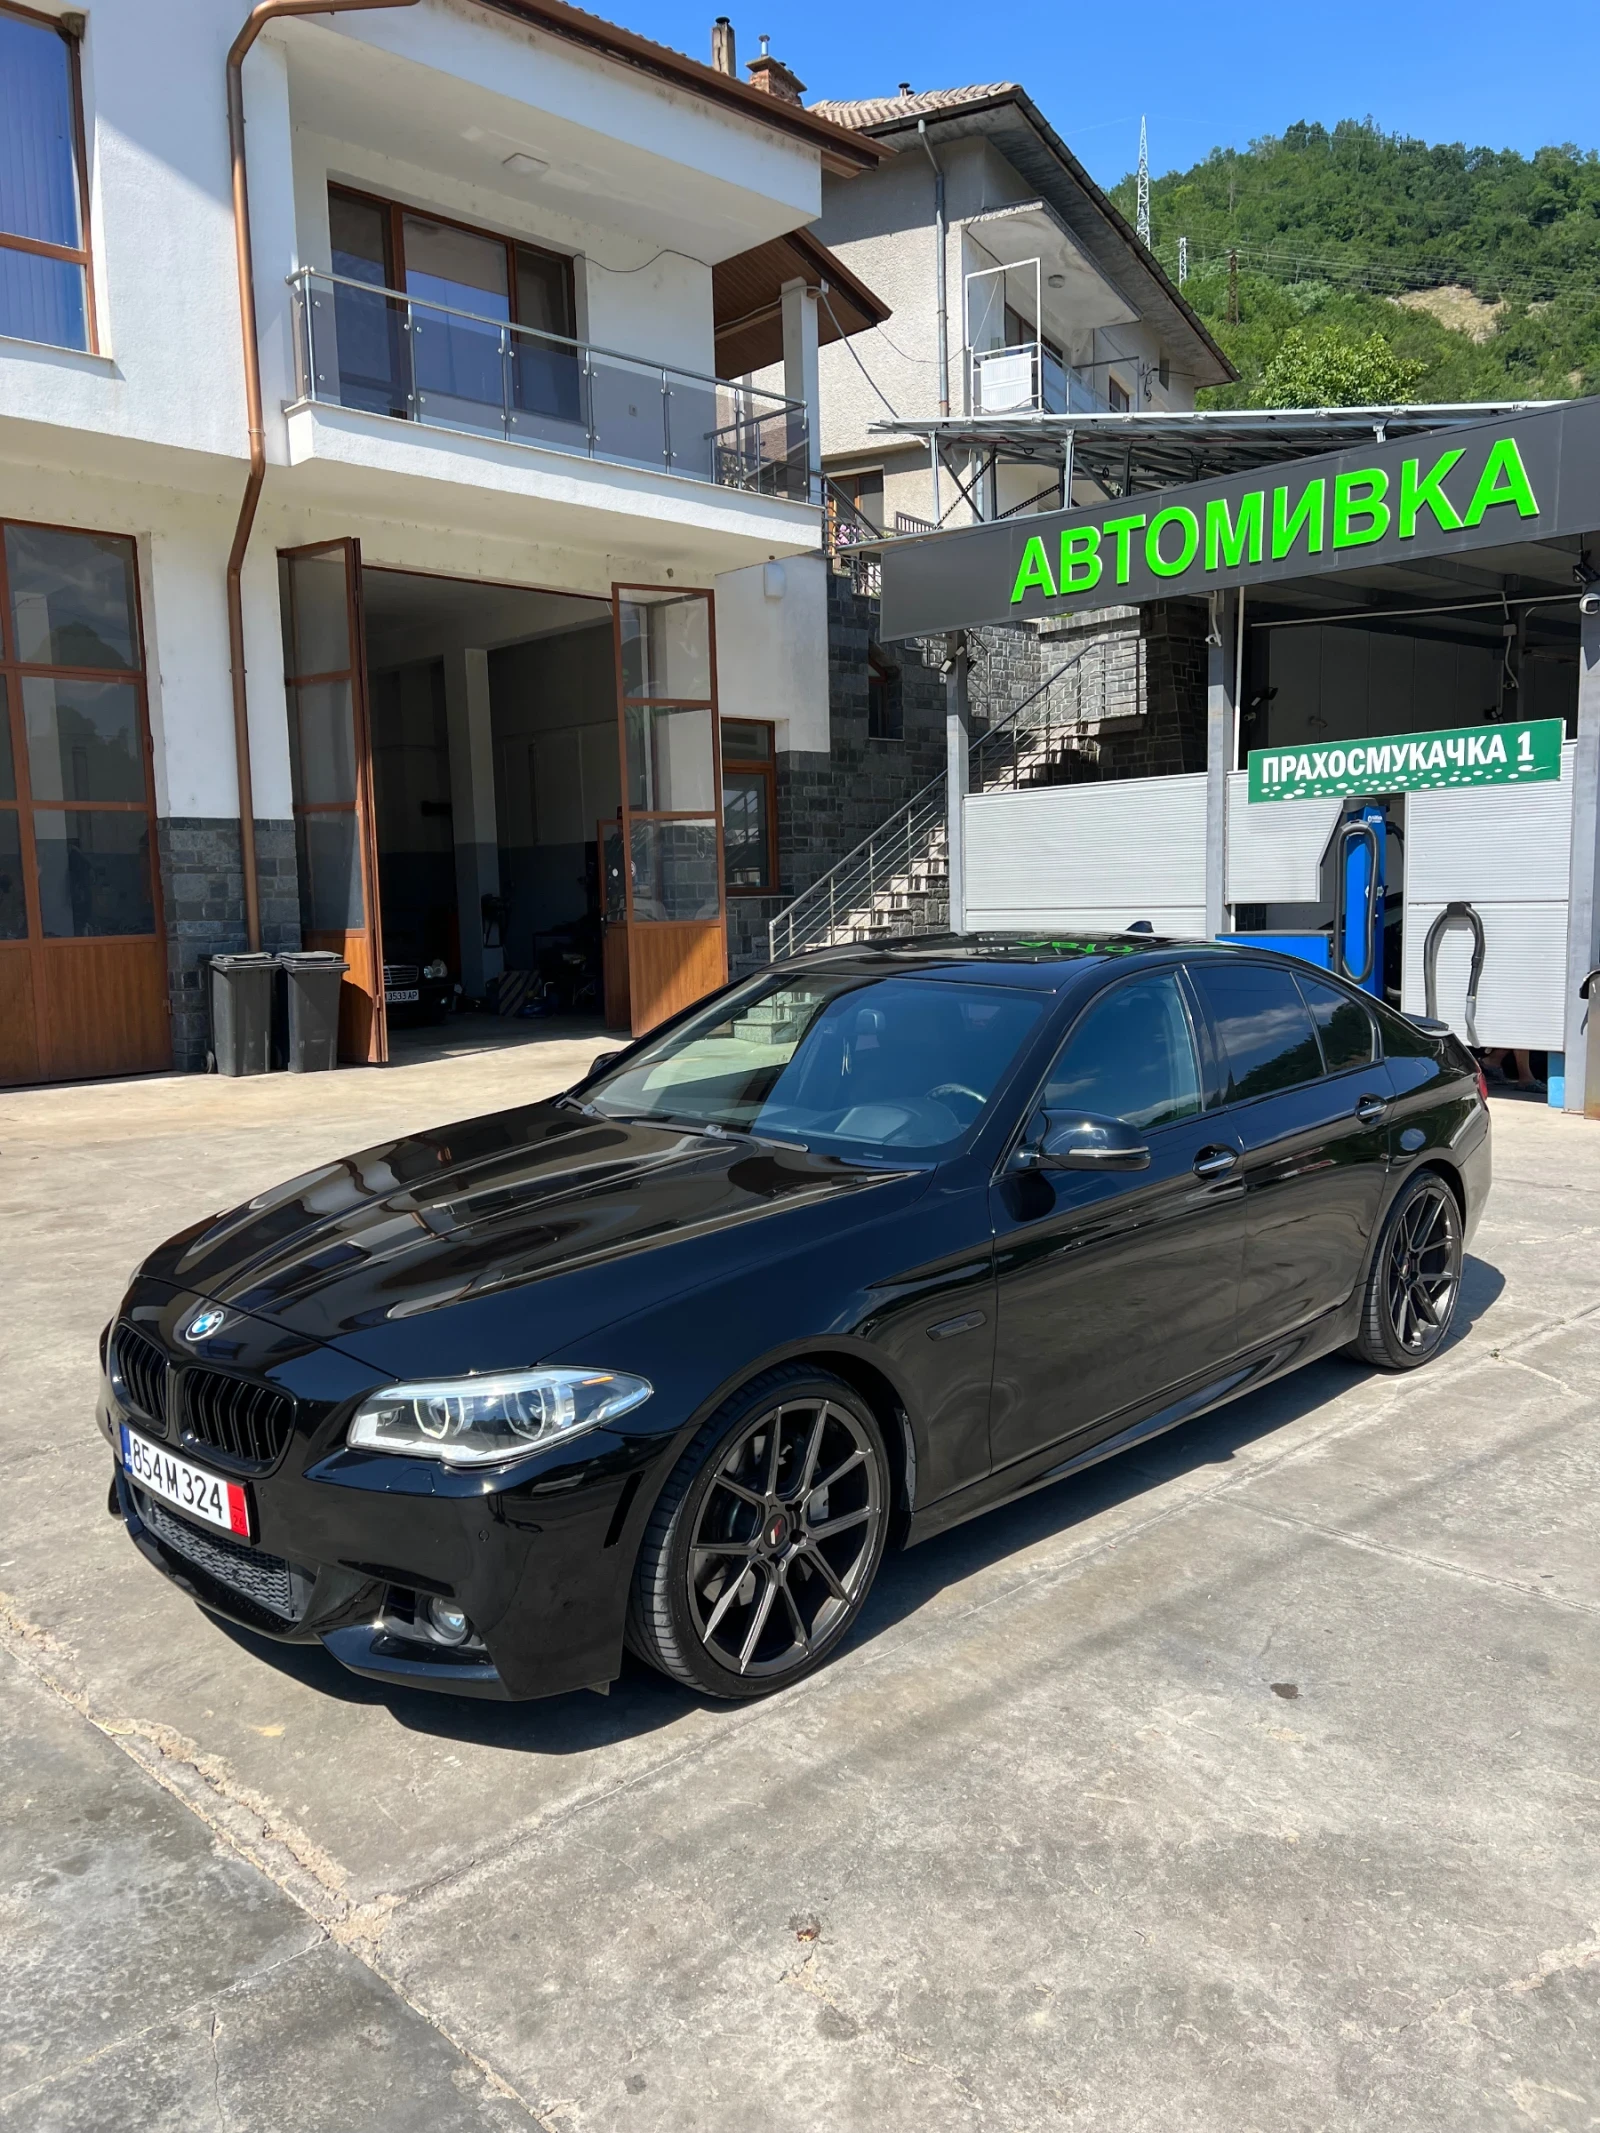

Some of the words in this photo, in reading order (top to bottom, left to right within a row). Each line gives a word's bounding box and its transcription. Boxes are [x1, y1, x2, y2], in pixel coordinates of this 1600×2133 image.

[1011, 438, 1540, 603] АВТОМИВКА
[1262, 734, 1507, 784] ПРАХОСМУКАЧКА
[1517, 731, 1534, 761] 1
